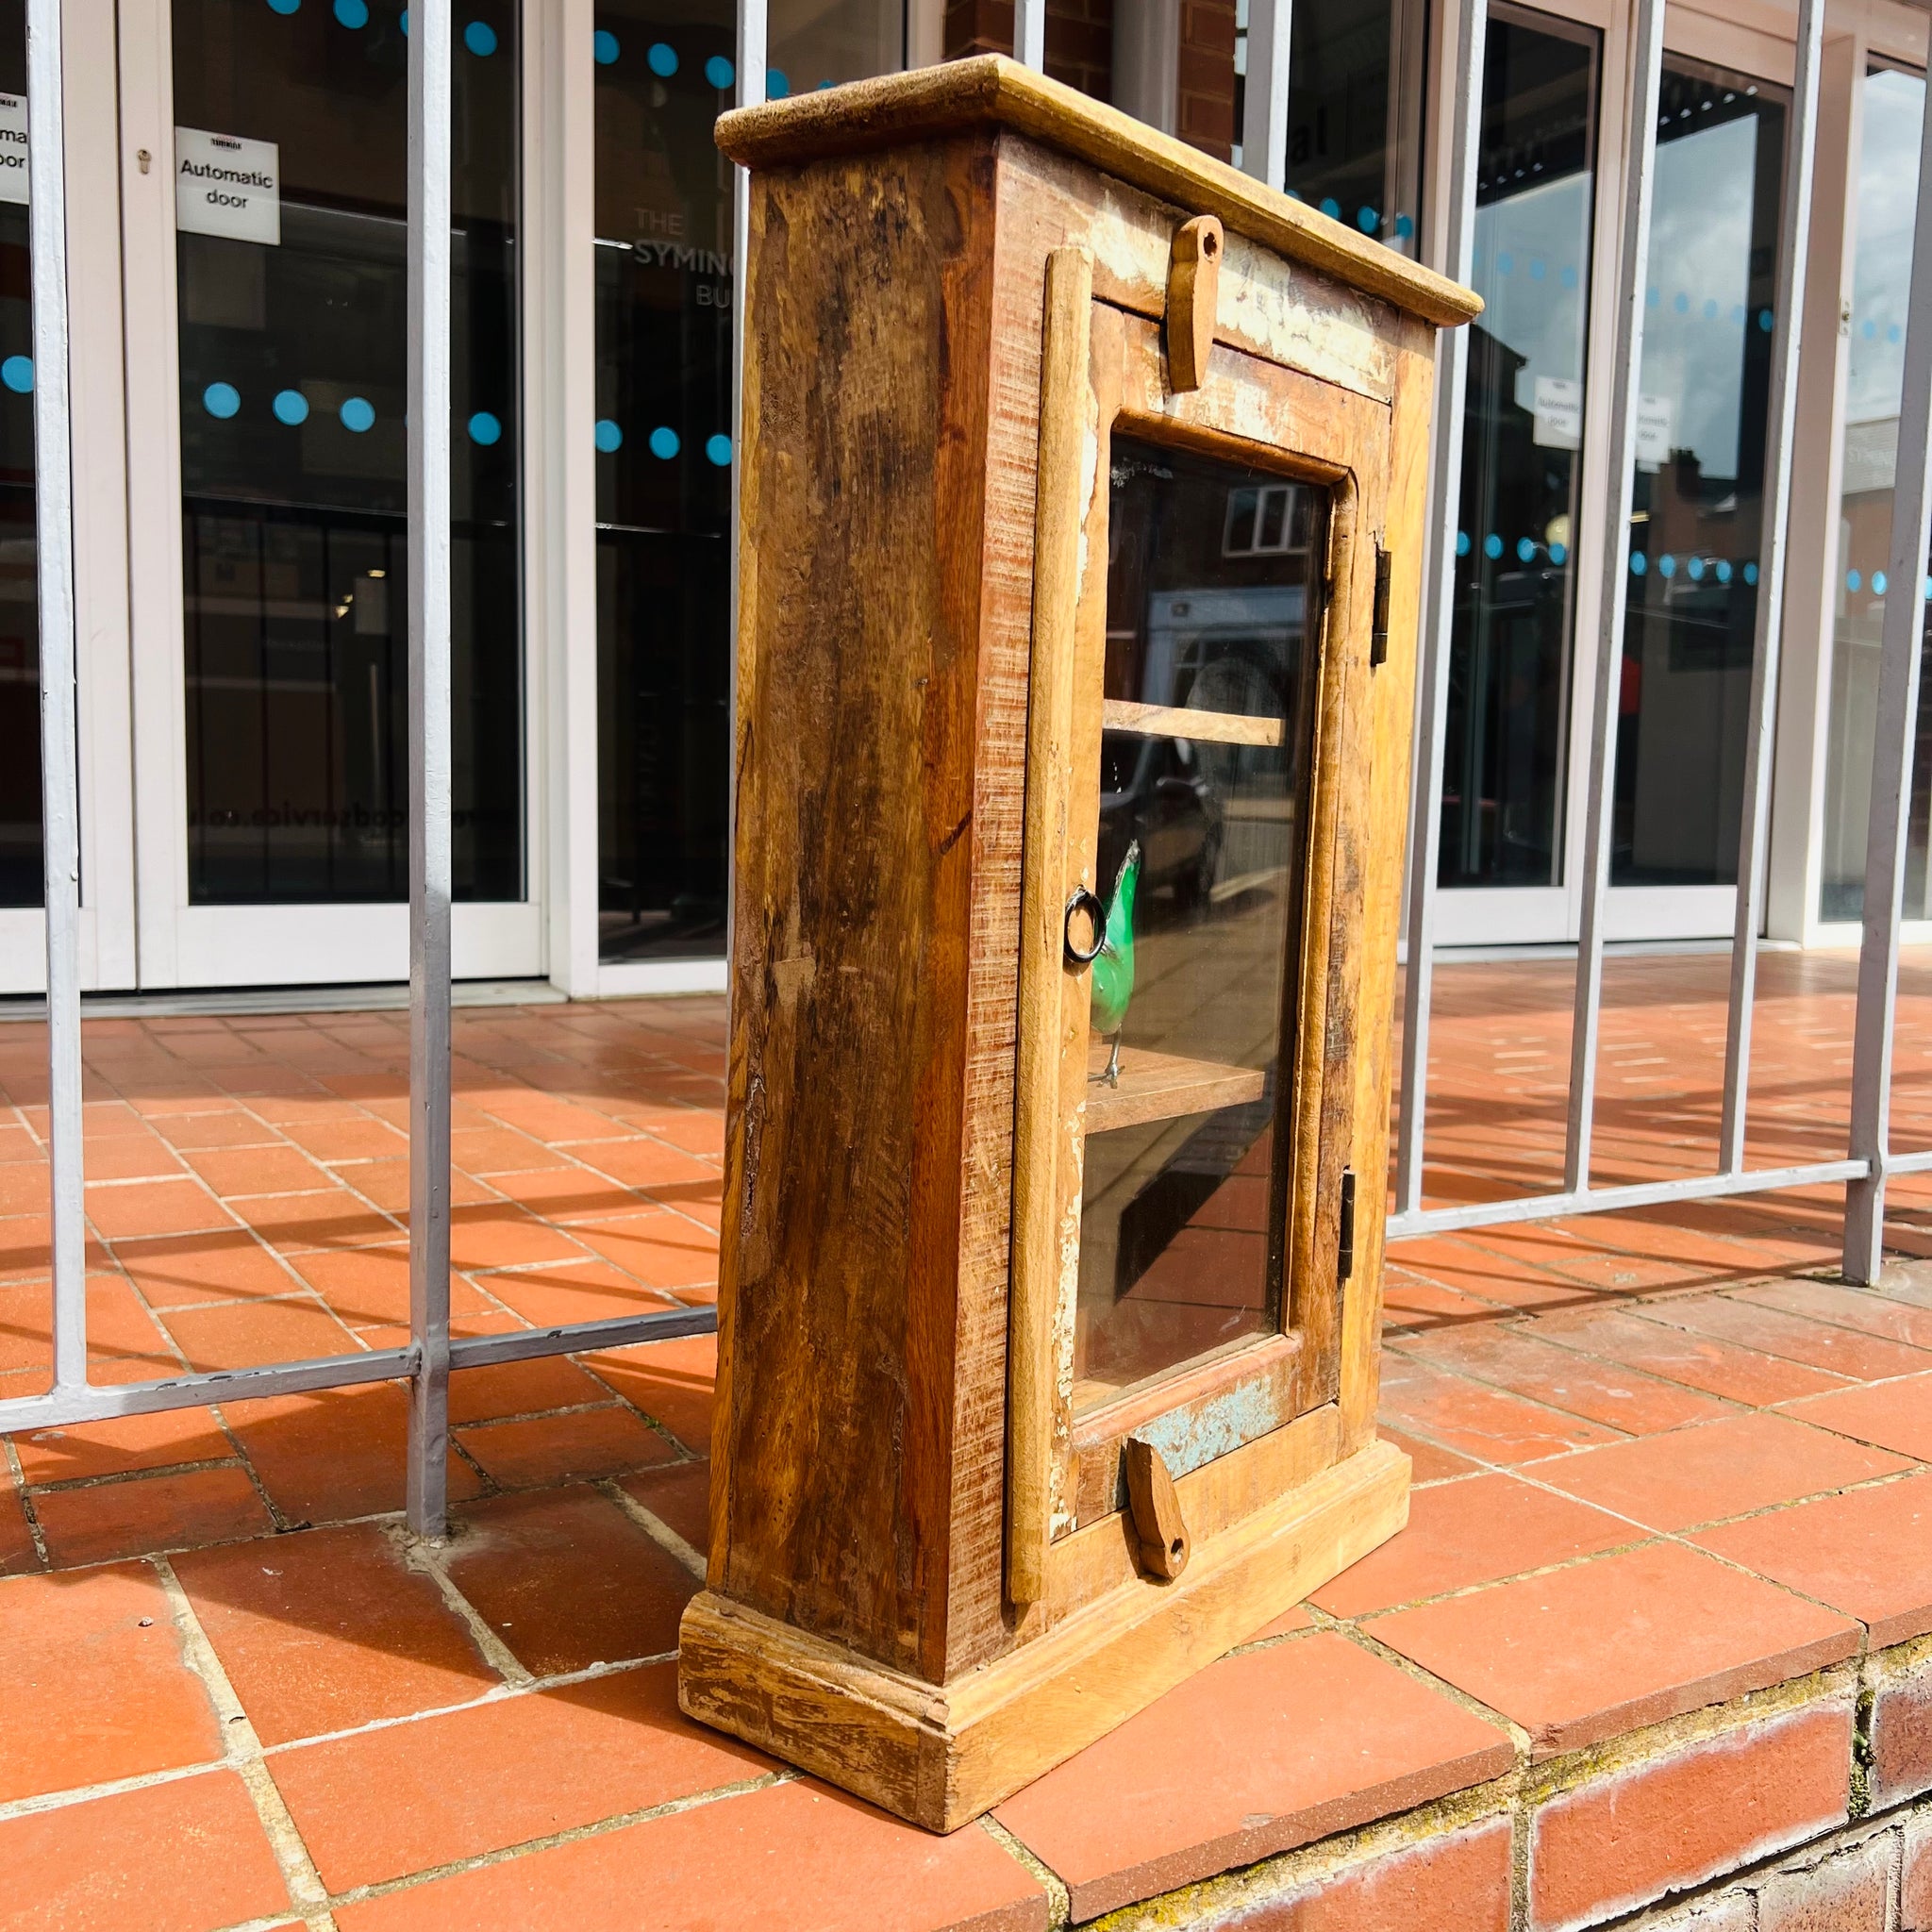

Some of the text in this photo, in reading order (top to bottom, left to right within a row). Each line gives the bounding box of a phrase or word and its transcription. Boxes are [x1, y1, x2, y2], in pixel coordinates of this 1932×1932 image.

[181, 159, 274, 189] Automatic
[207, 190, 248, 208] door
[634, 208, 684, 235] THE
[634, 240, 734, 276] SYMIN
[696, 285, 731, 308] BU
